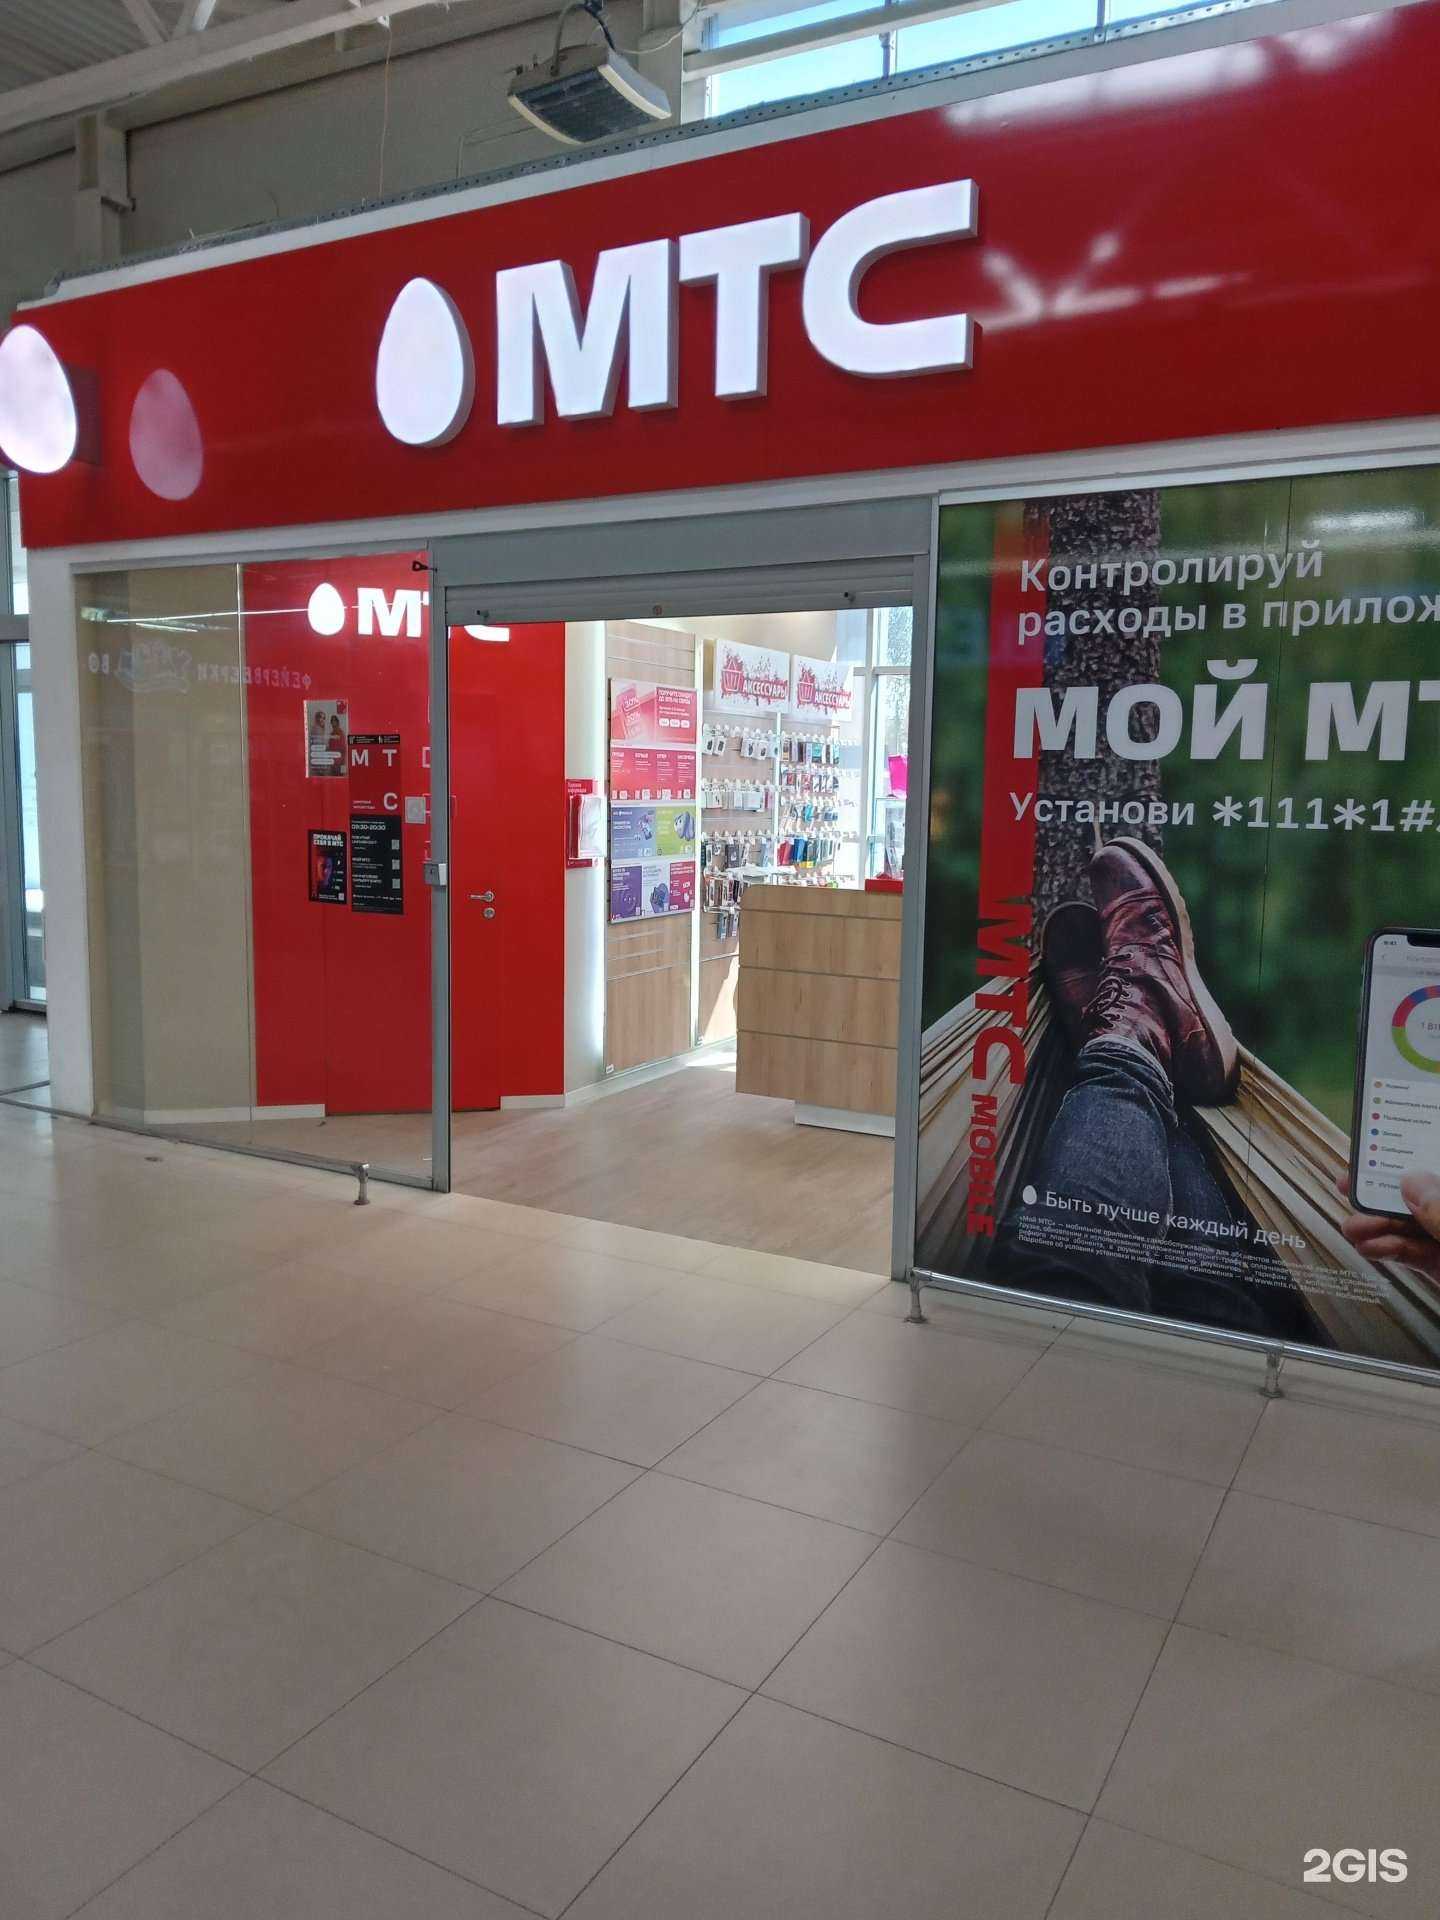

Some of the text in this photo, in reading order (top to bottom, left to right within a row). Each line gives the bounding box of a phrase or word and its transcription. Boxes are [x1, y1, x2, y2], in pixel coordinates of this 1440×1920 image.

[496, 178, 979, 428] МТС
[1020, 539, 1323, 596] Контролируй
[1018, 603, 1206, 645] расходы
[1223, 603, 1247, 629] в
[742, 679, 788, 699] АКСЕССУАРЫ
[1013, 659, 1440, 761] МОЙ М
[351, 749, 369, 767] М
[382, 749, 398, 767] Т
[1009, 792, 1196, 827] Установи
[1045, 1190, 1307, 1250] Быть лучше каждый день
